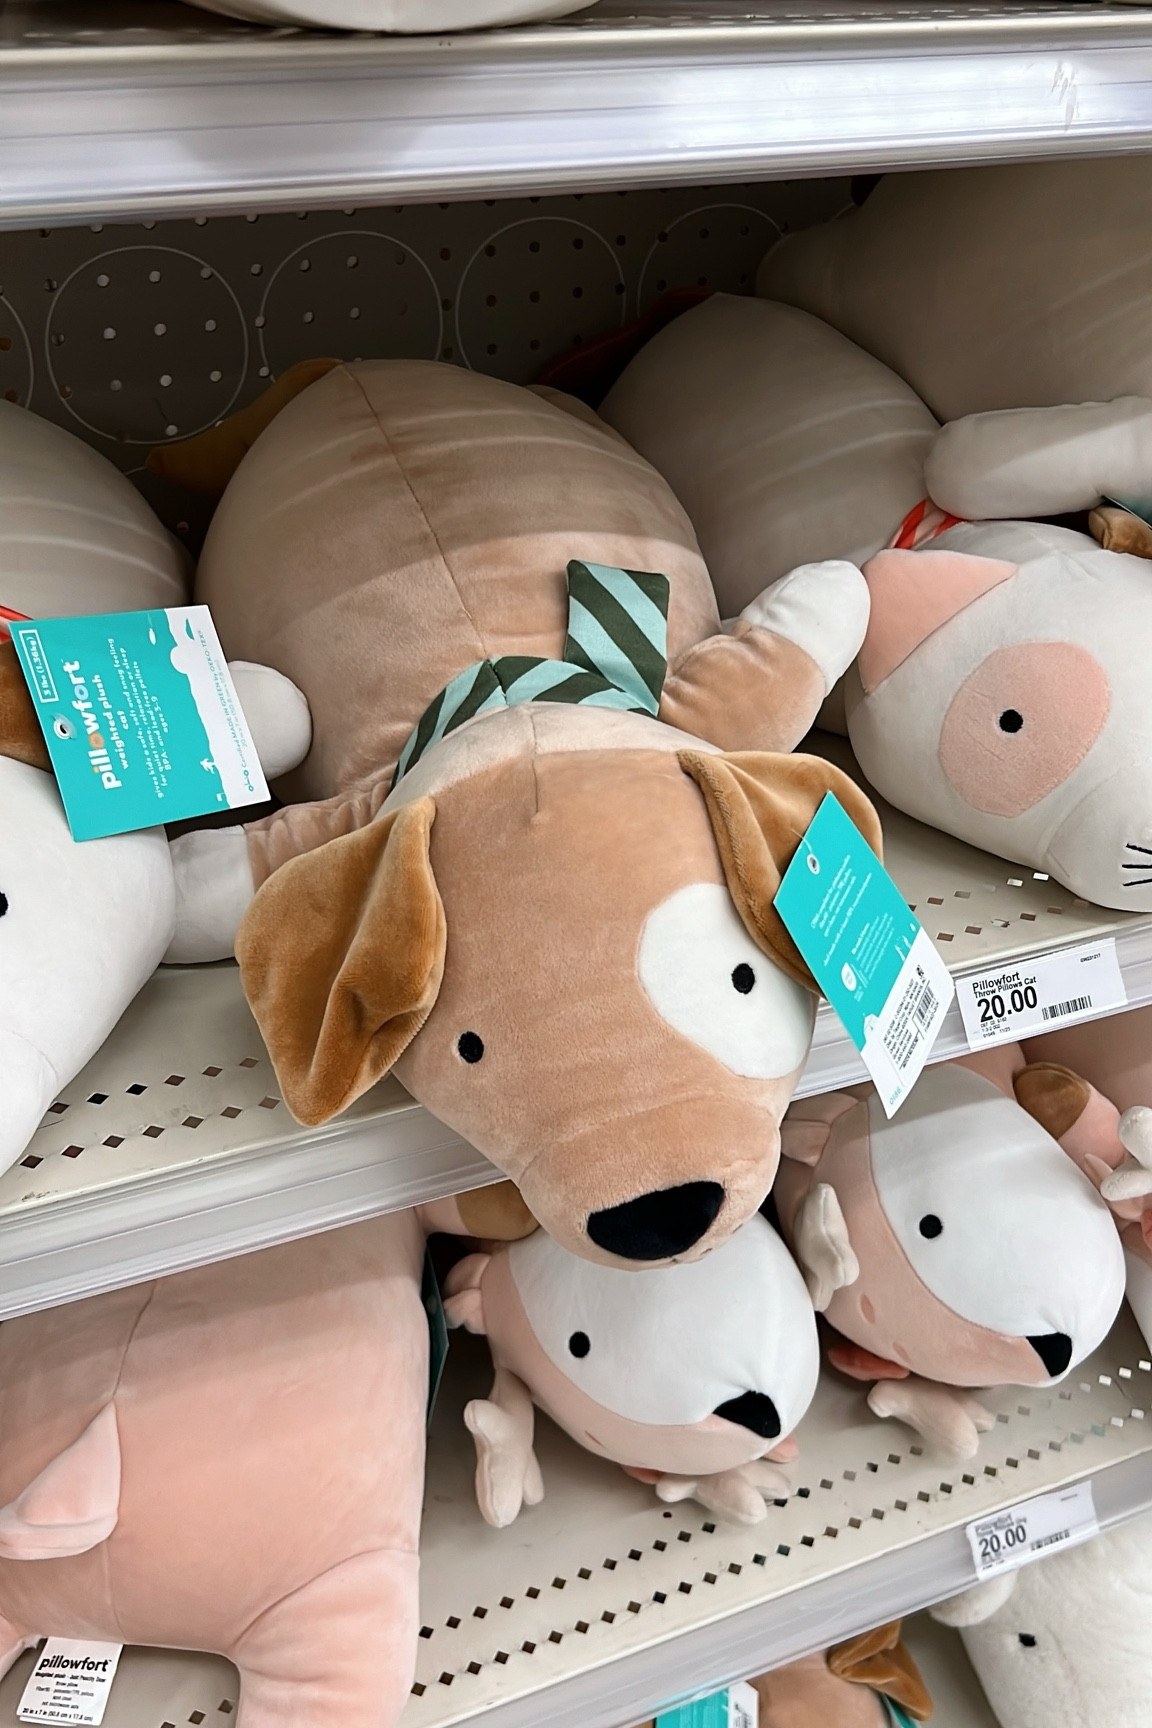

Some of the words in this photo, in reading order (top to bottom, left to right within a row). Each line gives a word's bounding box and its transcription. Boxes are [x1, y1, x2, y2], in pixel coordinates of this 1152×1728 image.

[107, 638, 121, 668] feeling
[119, 647, 130, 670] sleep
[117, 669, 128, 690] snug
[133, 661, 147, 689] pellets
[92, 674, 112, 709] plush
[122, 691, 134, 708] and
[130, 681, 148, 725] relaxation
[215, 682, 227, 707] GREEN
[116, 710, 129, 730] cat
[223, 707, 230, 716] IN
[64, 661, 121, 789] pillowfort
[226, 717, 237, 739] MADE
[103, 711, 129, 769] weighted
[153, 730, 164, 747] and
[145, 757, 155, 775] kids
[152, 750, 165, 772] quiet
[152, 776, 164, 799] gives
[160, 773, 168, 787] for
[972, 972, 1020, 992] Pillowfort
[973, 988, 996, 999] Throw
[997, 981, 1023, 993] Pillows
[1023, 976, 1037, 985] Cat
[977, 986, 1038, 1022] 20.00
[979, 1525, 1026, 1558] 20.00
[38, 1655, 109, 1672] pillowfort
